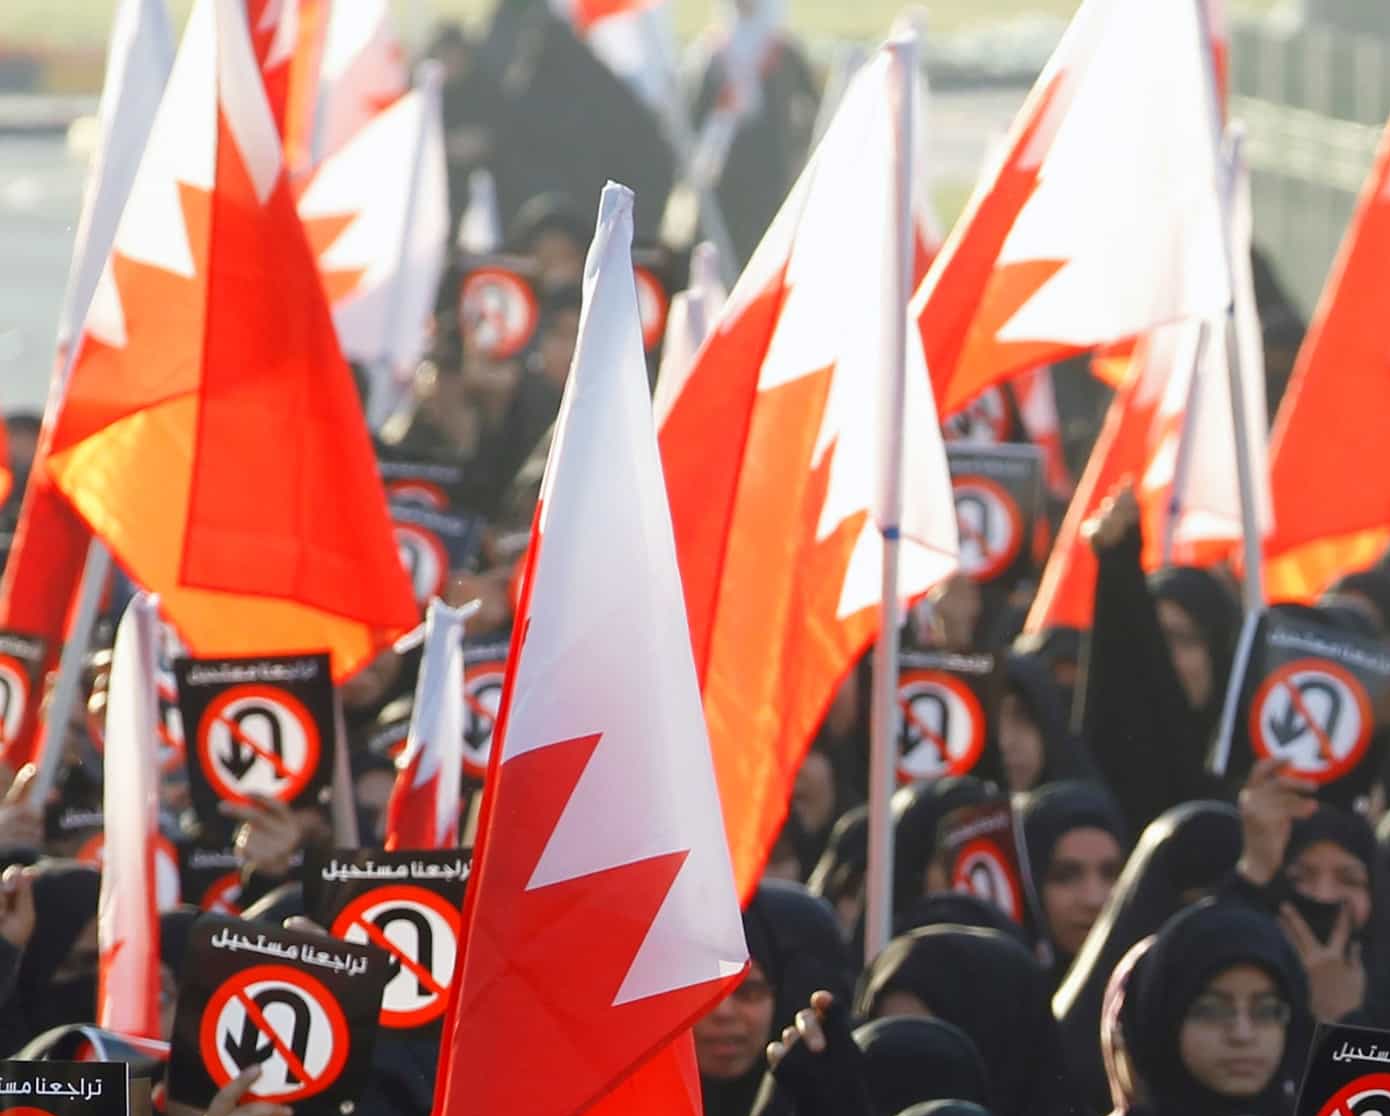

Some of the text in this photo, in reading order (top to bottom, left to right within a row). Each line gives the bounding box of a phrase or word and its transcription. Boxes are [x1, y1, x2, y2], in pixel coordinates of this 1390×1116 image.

[321, 859, 409, 882] مستحيل
[211, 926, 368, 976] تراجعنا مستحيل
[35, 1076, 103, 1100] تراجعنا
